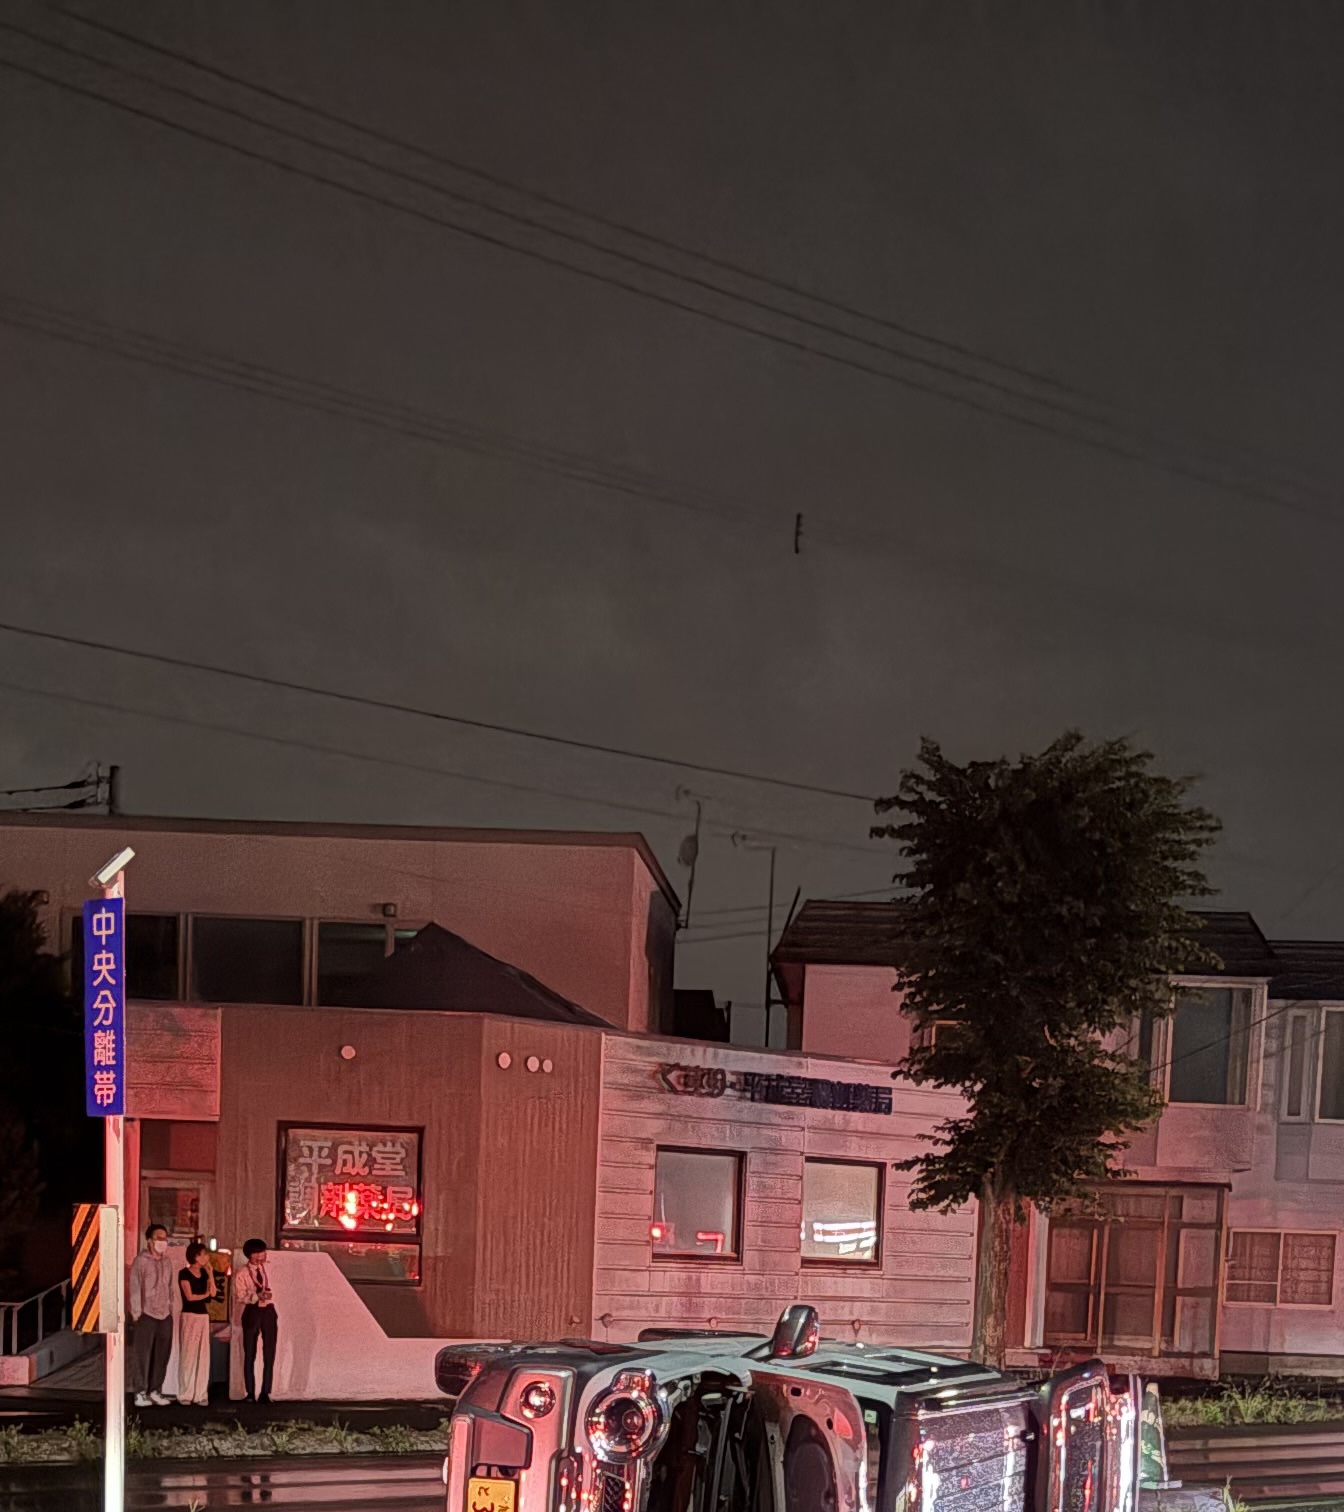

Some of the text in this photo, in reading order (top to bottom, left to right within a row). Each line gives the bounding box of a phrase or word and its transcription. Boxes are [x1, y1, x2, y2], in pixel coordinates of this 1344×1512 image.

[92, 906, 117, 1108] 中央分離帯
[298, 1140, 407, 1176] 平成堂
